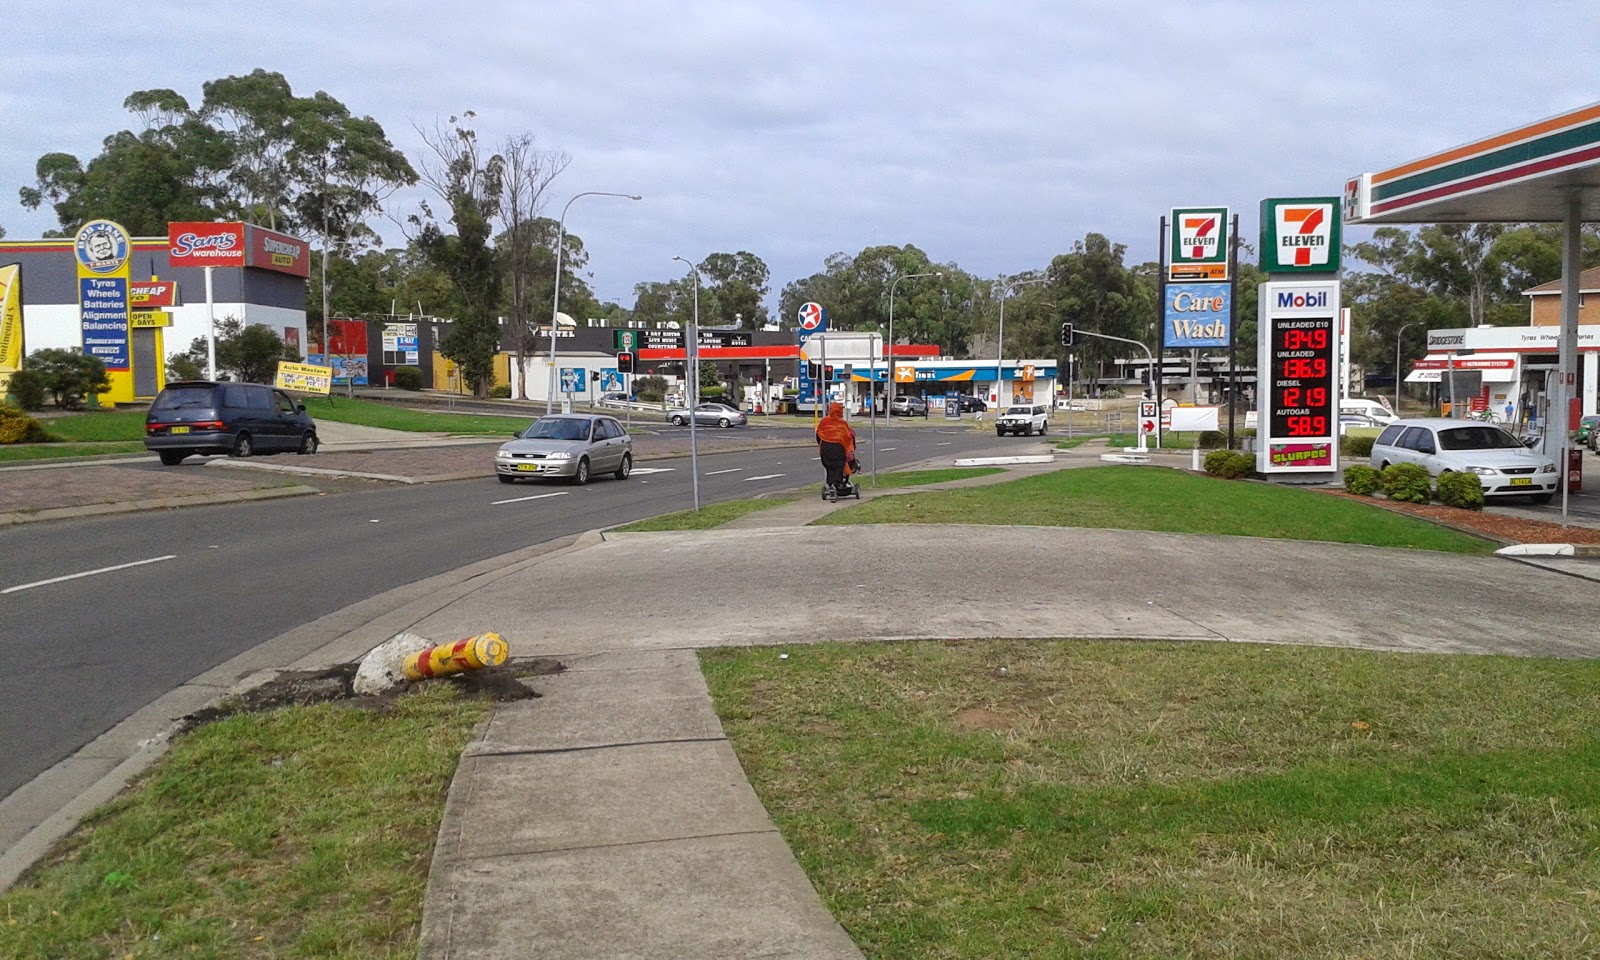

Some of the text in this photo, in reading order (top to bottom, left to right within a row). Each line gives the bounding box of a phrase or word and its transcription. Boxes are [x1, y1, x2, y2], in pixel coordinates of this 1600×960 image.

[78, 224, 124, 249] BOB JANE
[1184, 217, 1215, 258] 7
[1284, 208, 1324, 265] 7
[264, 237, 301, 259] SUPERCHEAP
[192, 249, 243, 258] warehouse
[274, 255, 292, 265] AUTO
[90, 279, 117, 289] Tyres
[87, 290, 121, 298] Wheels
[131, 286, 166, 296] CHEAP
[83, 301, 125, 309] Batteries
[1173, 291, 1225, 314] Care
[1277, 292, 1328, 308] Mobil
[82, 311, 128, 321] Alignment
[82, 322, 128, 332] Balancing
[1172, 319, 1227, 340] Wash
[1277, 321, 1315, 329] UNLEADED
[1428, 335, 1465, 346] BRIDGESTONE
[301, 366, 328, 375] Masters
[1276, 408, 1310, 416] AUTOGAS
[1287, 416, 1326, 436] 58.9
[1272, 449, 1327, 463] SLURPEE
